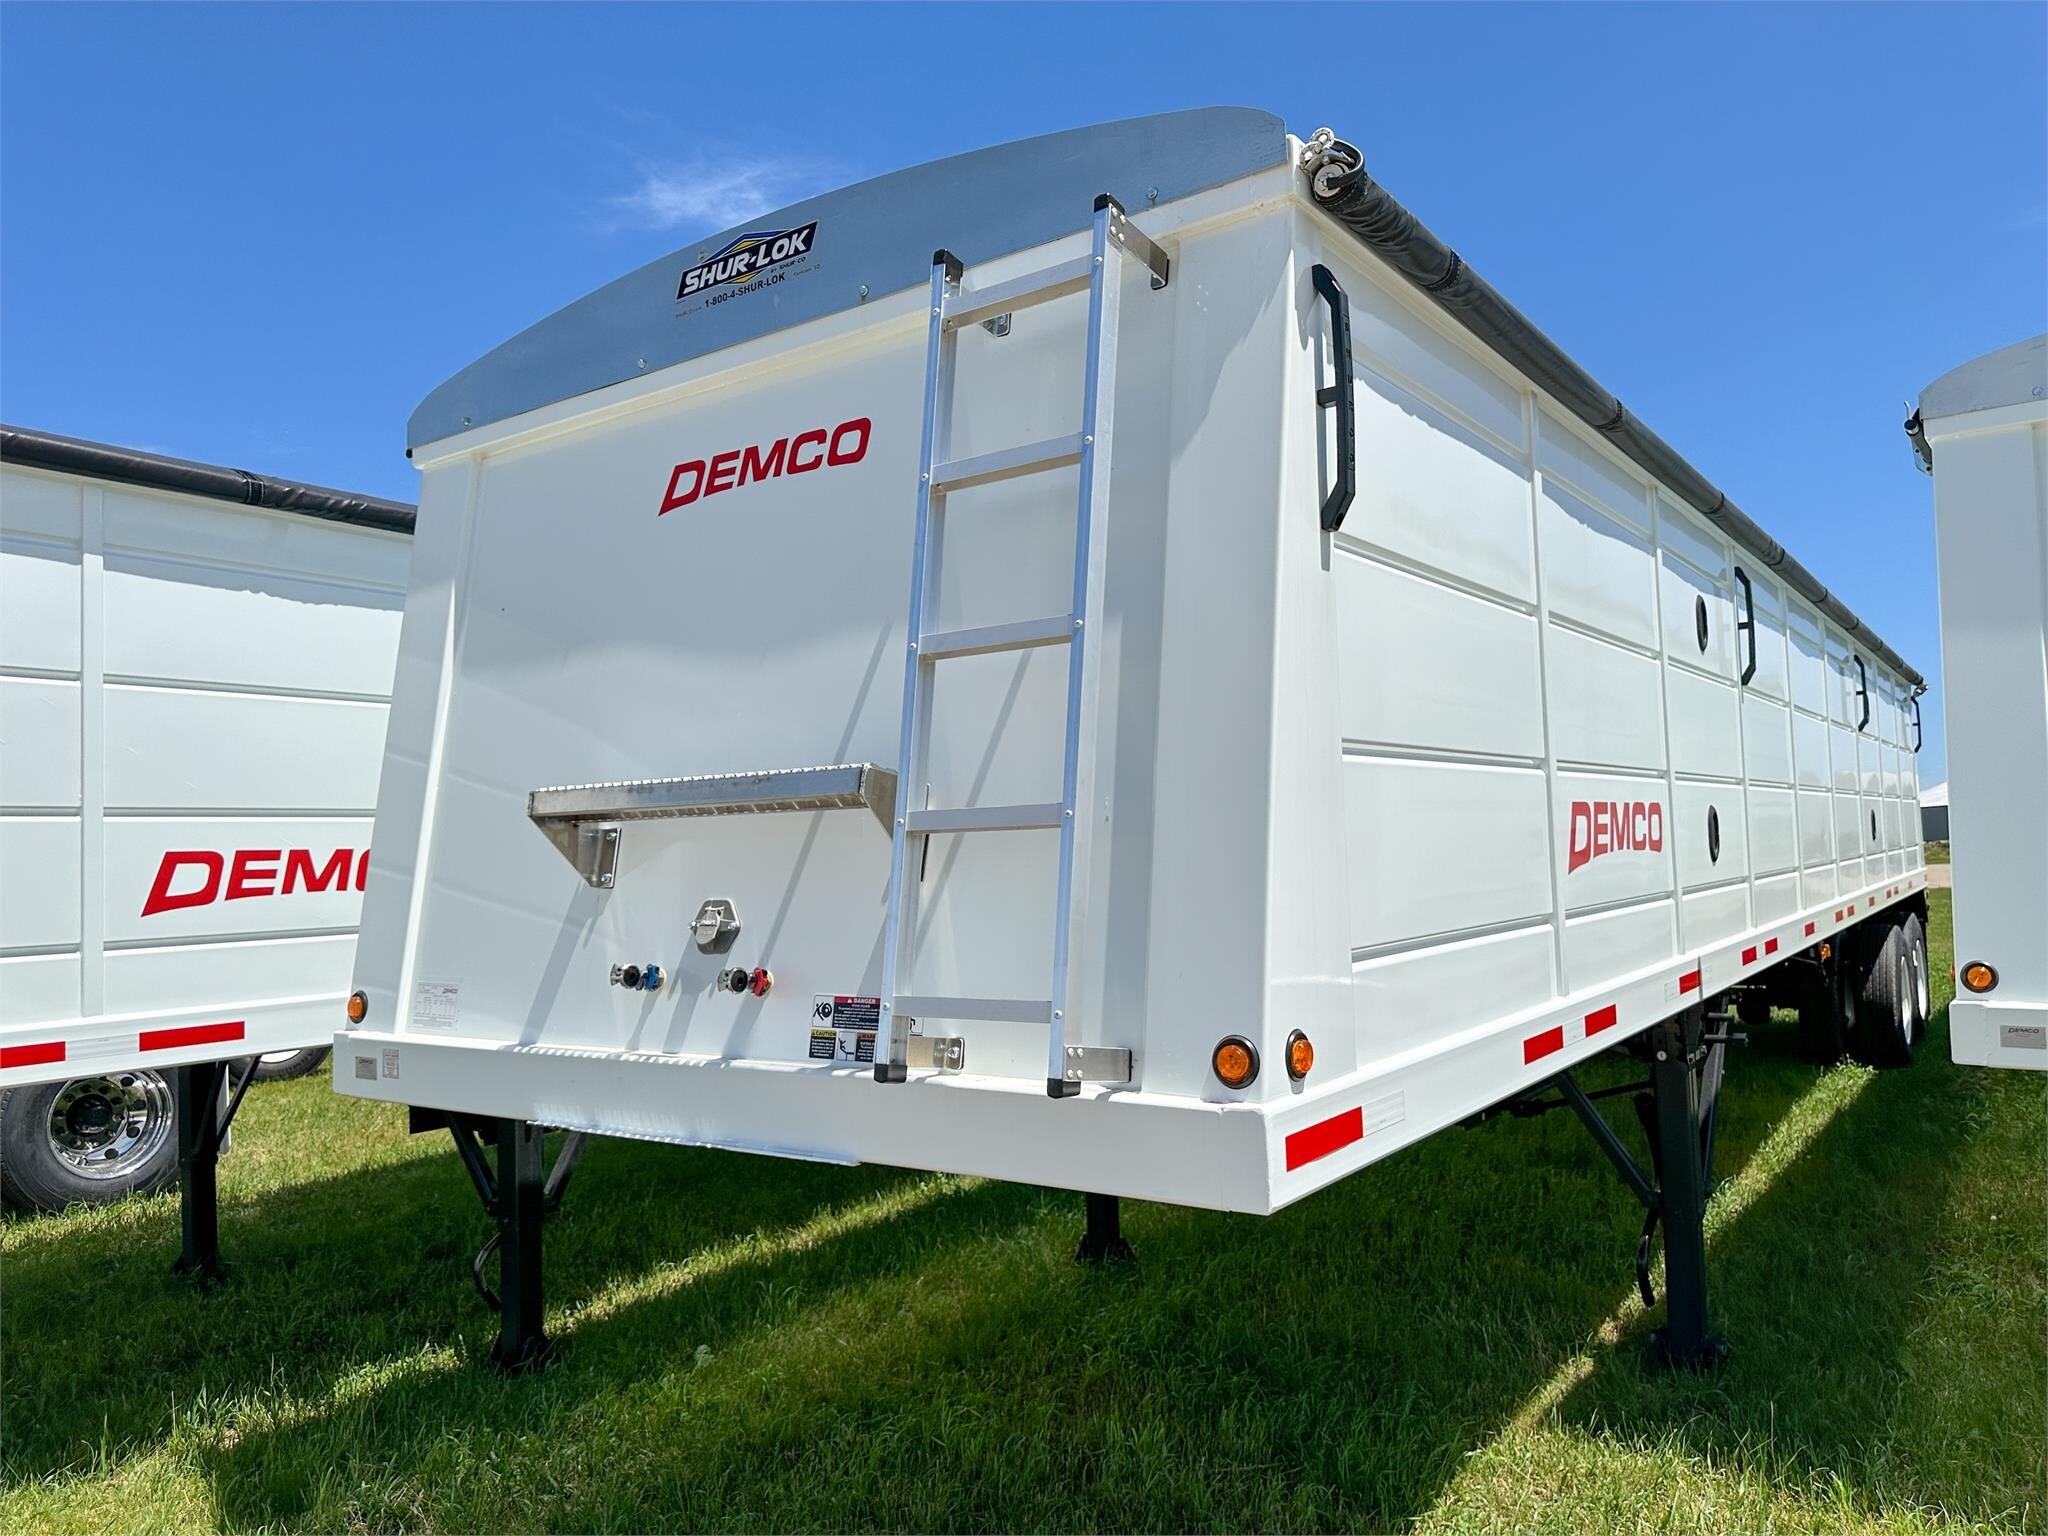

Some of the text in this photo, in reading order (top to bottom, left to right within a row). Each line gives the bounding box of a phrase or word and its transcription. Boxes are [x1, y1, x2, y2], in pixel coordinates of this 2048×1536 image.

[683, 228, 810, 295] SHUR-LOK
[705, 272, 785, 308] 1-800-4-SHUR-LOK
[658, 417, 872, 517] DEMCO
[1568, 801, 1663, 876] DEMCO
